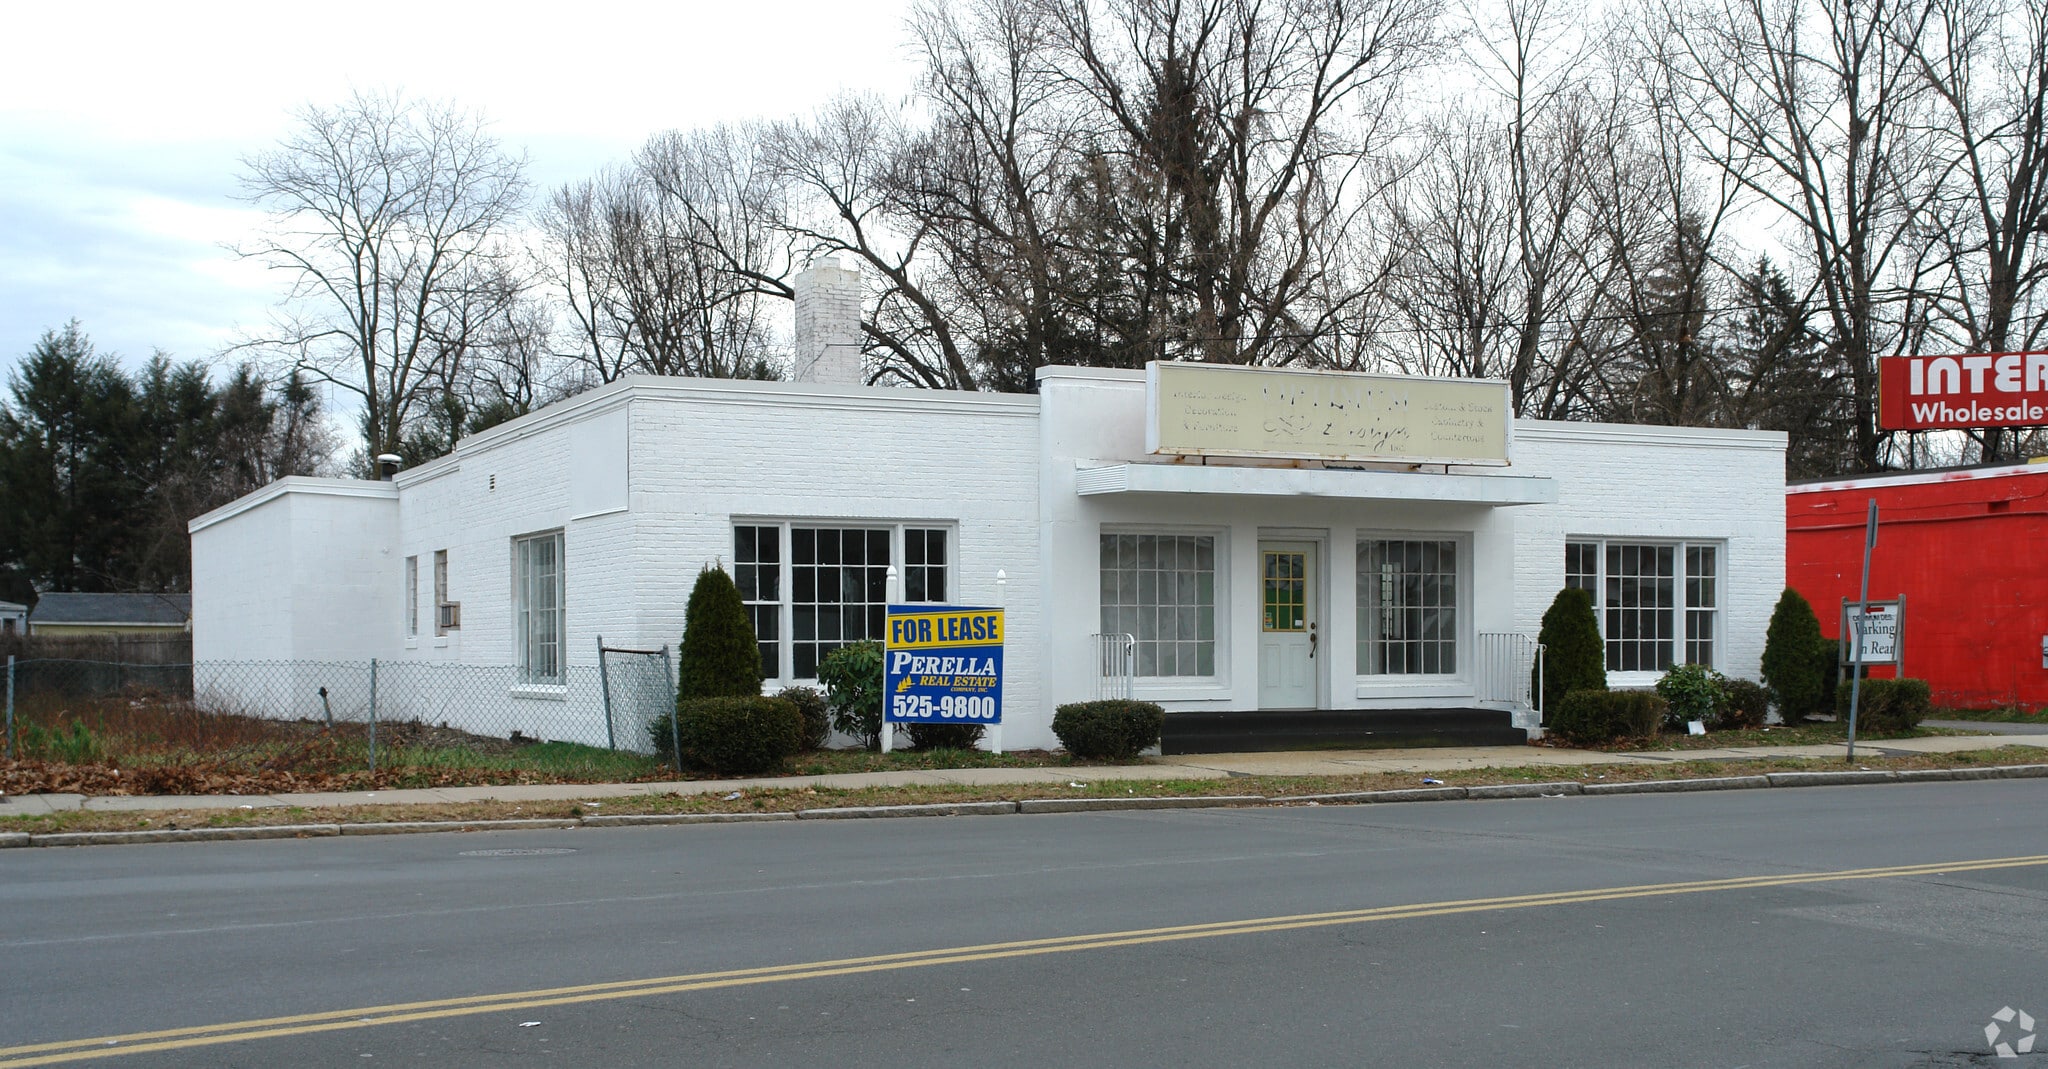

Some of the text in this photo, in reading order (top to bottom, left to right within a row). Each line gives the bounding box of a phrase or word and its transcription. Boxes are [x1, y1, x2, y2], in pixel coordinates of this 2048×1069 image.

[892, 616, 998, 644] FOR LEASE
[1871, 641, 1894, 655] Rear
[890, 651, 997, 676] PERELLA
[919, 675, 998, 687] REAL ESTATE
[893, 695, 995, 719] 525-9800
